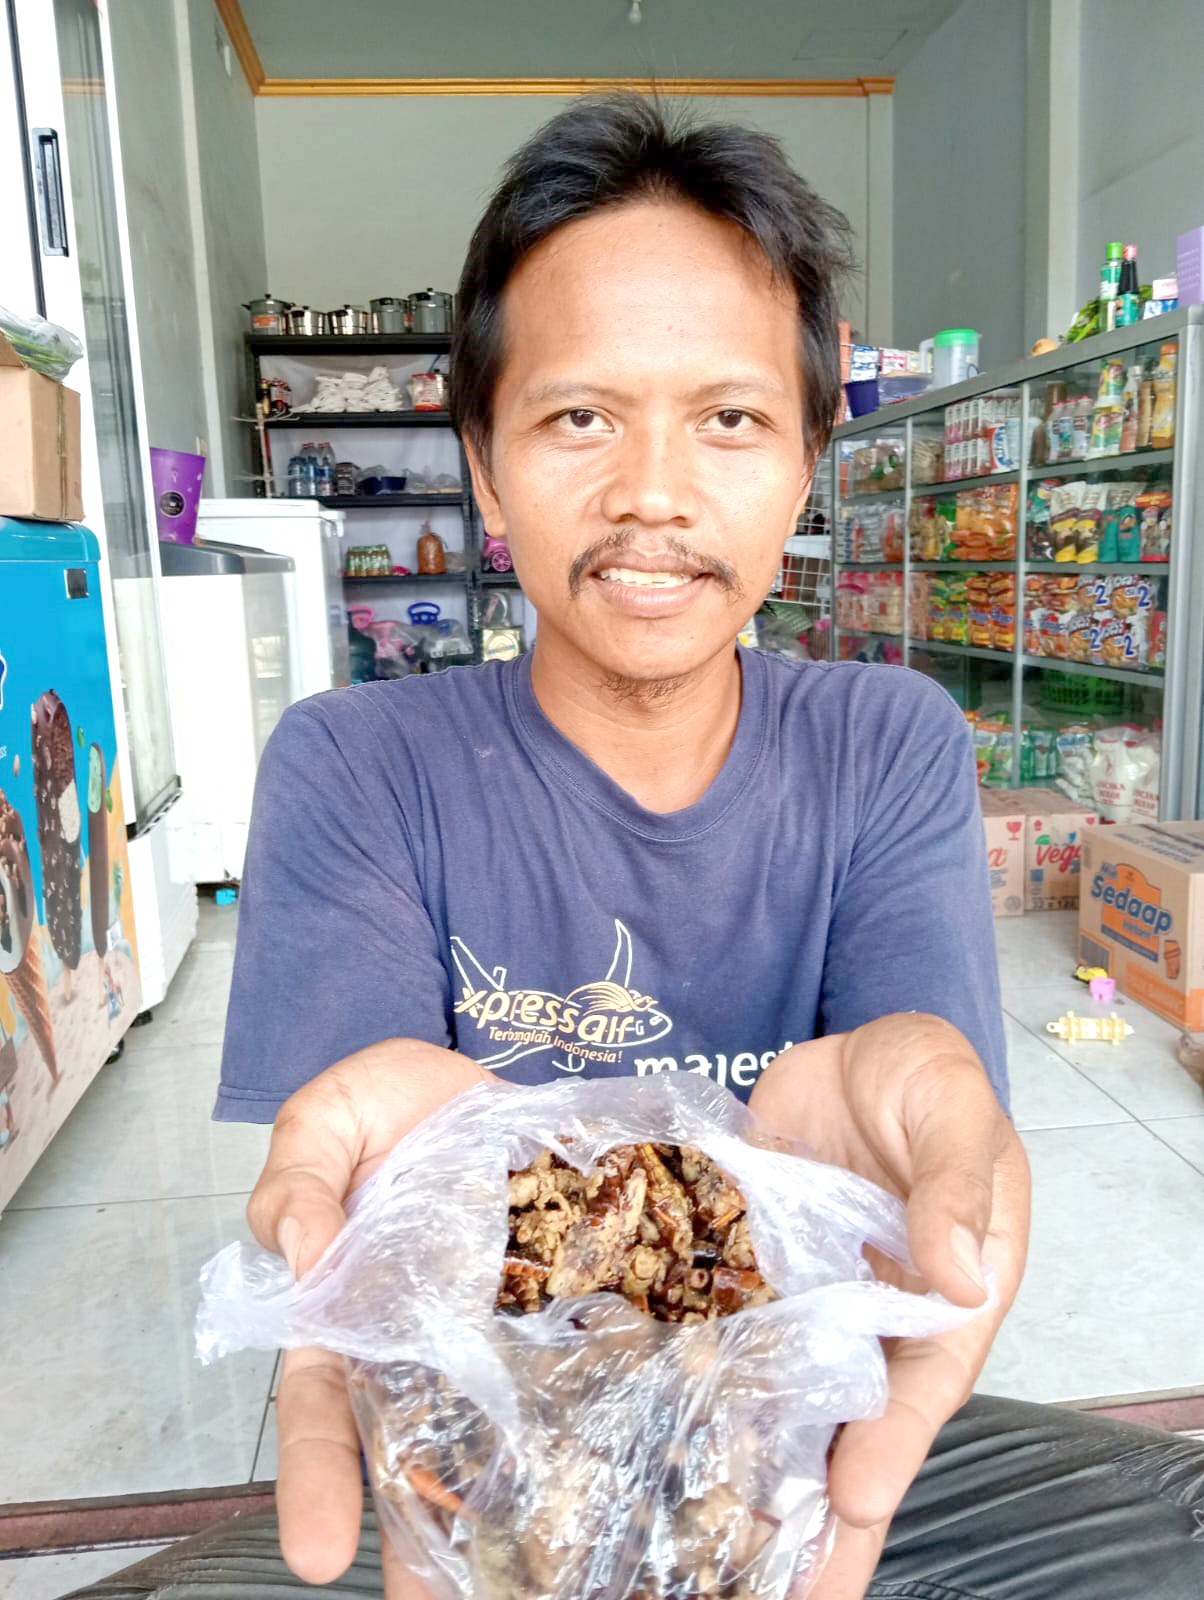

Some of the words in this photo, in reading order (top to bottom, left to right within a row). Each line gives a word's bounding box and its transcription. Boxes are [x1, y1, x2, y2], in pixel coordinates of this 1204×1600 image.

[1095, 584, 1108, 605] 2
[1137, 585, 1151, 608] 2
[1090, 628, 1101, 649] 2
[1124, 635, 1134, 656] 2
[1091, 874, 1172, 934] Sedaap
[634, 1041, 794, 1087] maje
